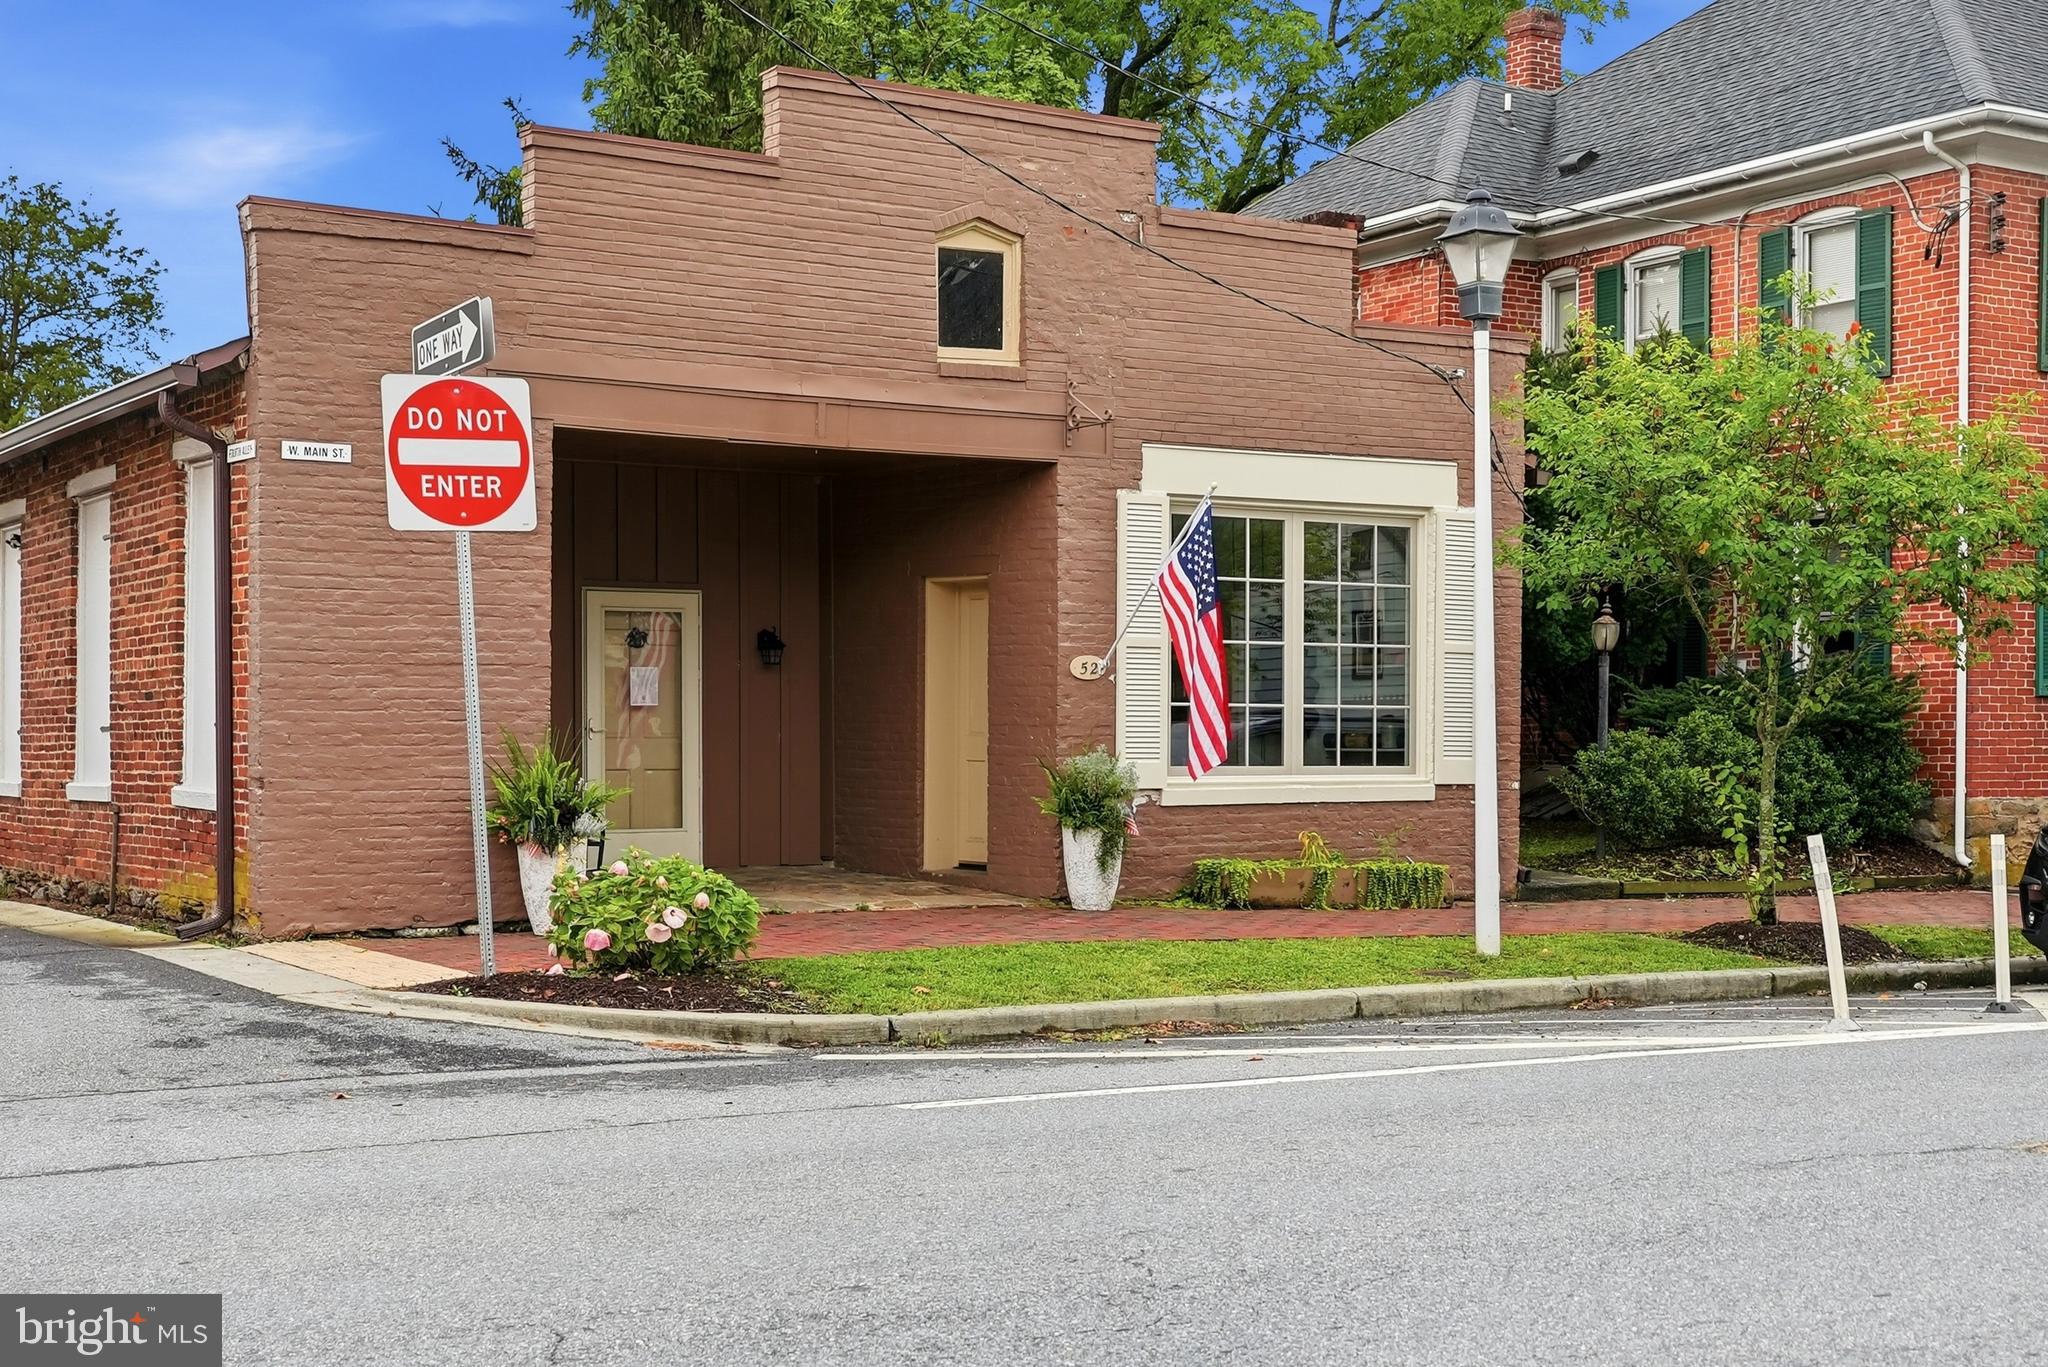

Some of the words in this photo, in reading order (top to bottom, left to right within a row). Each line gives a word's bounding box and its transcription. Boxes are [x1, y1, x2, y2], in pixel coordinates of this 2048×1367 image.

[419, 338, 439, 365] ONE
[442, 325, 463, 354] WAY
[407, 406, 443, 431] DO
[456, 408, 507, 432] NOT
[288, 445, 299, 456] W.
[304, 446, 328, 457] MAIN
[332, 448, 345, 459] ST.
[421, 474, 502, 498] ENTER
